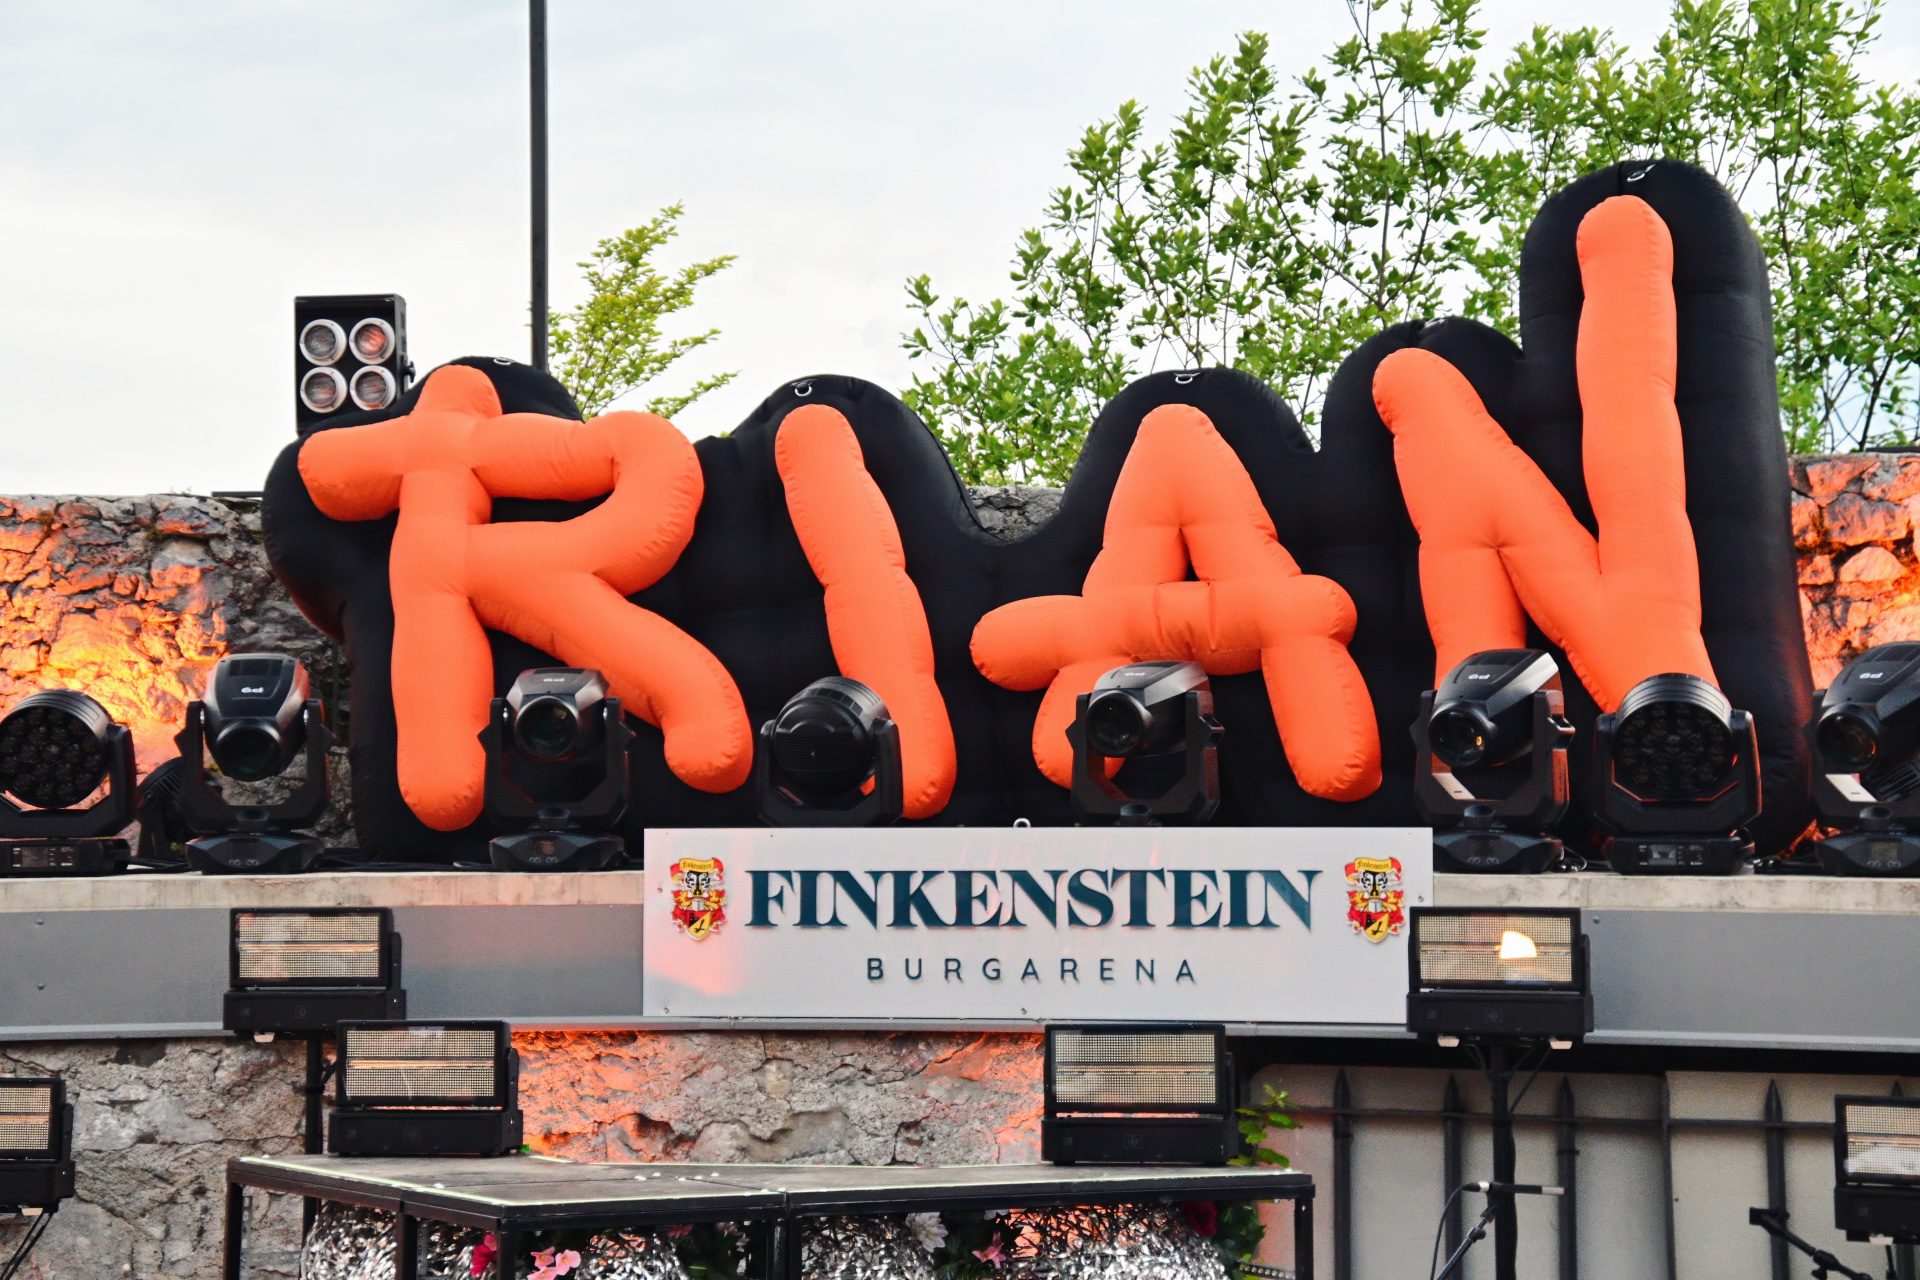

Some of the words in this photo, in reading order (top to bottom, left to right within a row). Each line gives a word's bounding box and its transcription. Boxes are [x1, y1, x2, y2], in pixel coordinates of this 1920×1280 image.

[297, 195, 1719, 832] RIAN
[745, 868, 1323, 930] FINKENSTEIN
[867, 957, 1195, 983] BURGARENA
